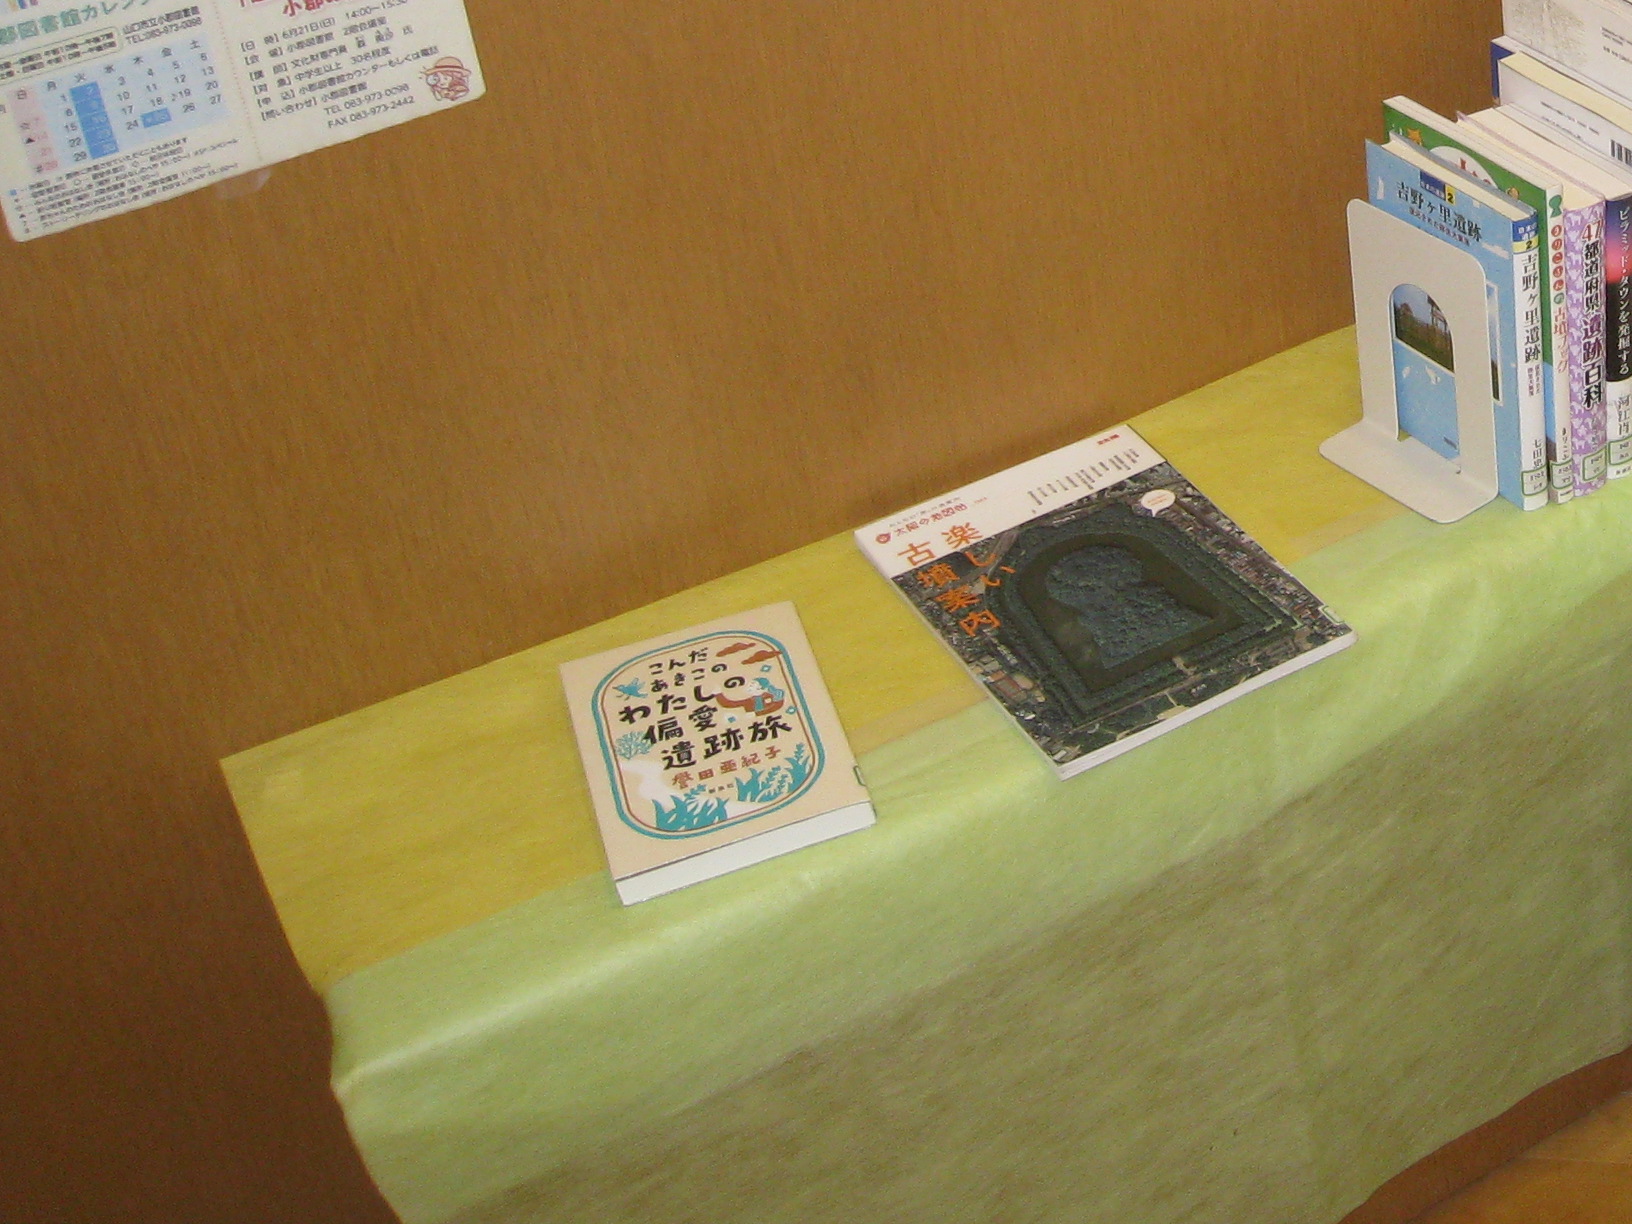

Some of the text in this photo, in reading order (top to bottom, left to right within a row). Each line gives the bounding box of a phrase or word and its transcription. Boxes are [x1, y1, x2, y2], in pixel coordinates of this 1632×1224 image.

[897, 540, 1001, 637] 古墳案内
[649, 647, 709, 676] こんだ
[650, 662, 728, 693] あきこの
[618, 675, 746, 725] わたしの
[642, 704, 718, 745] 偏愛
[661, 715, 793, 771] 遺跡旅
